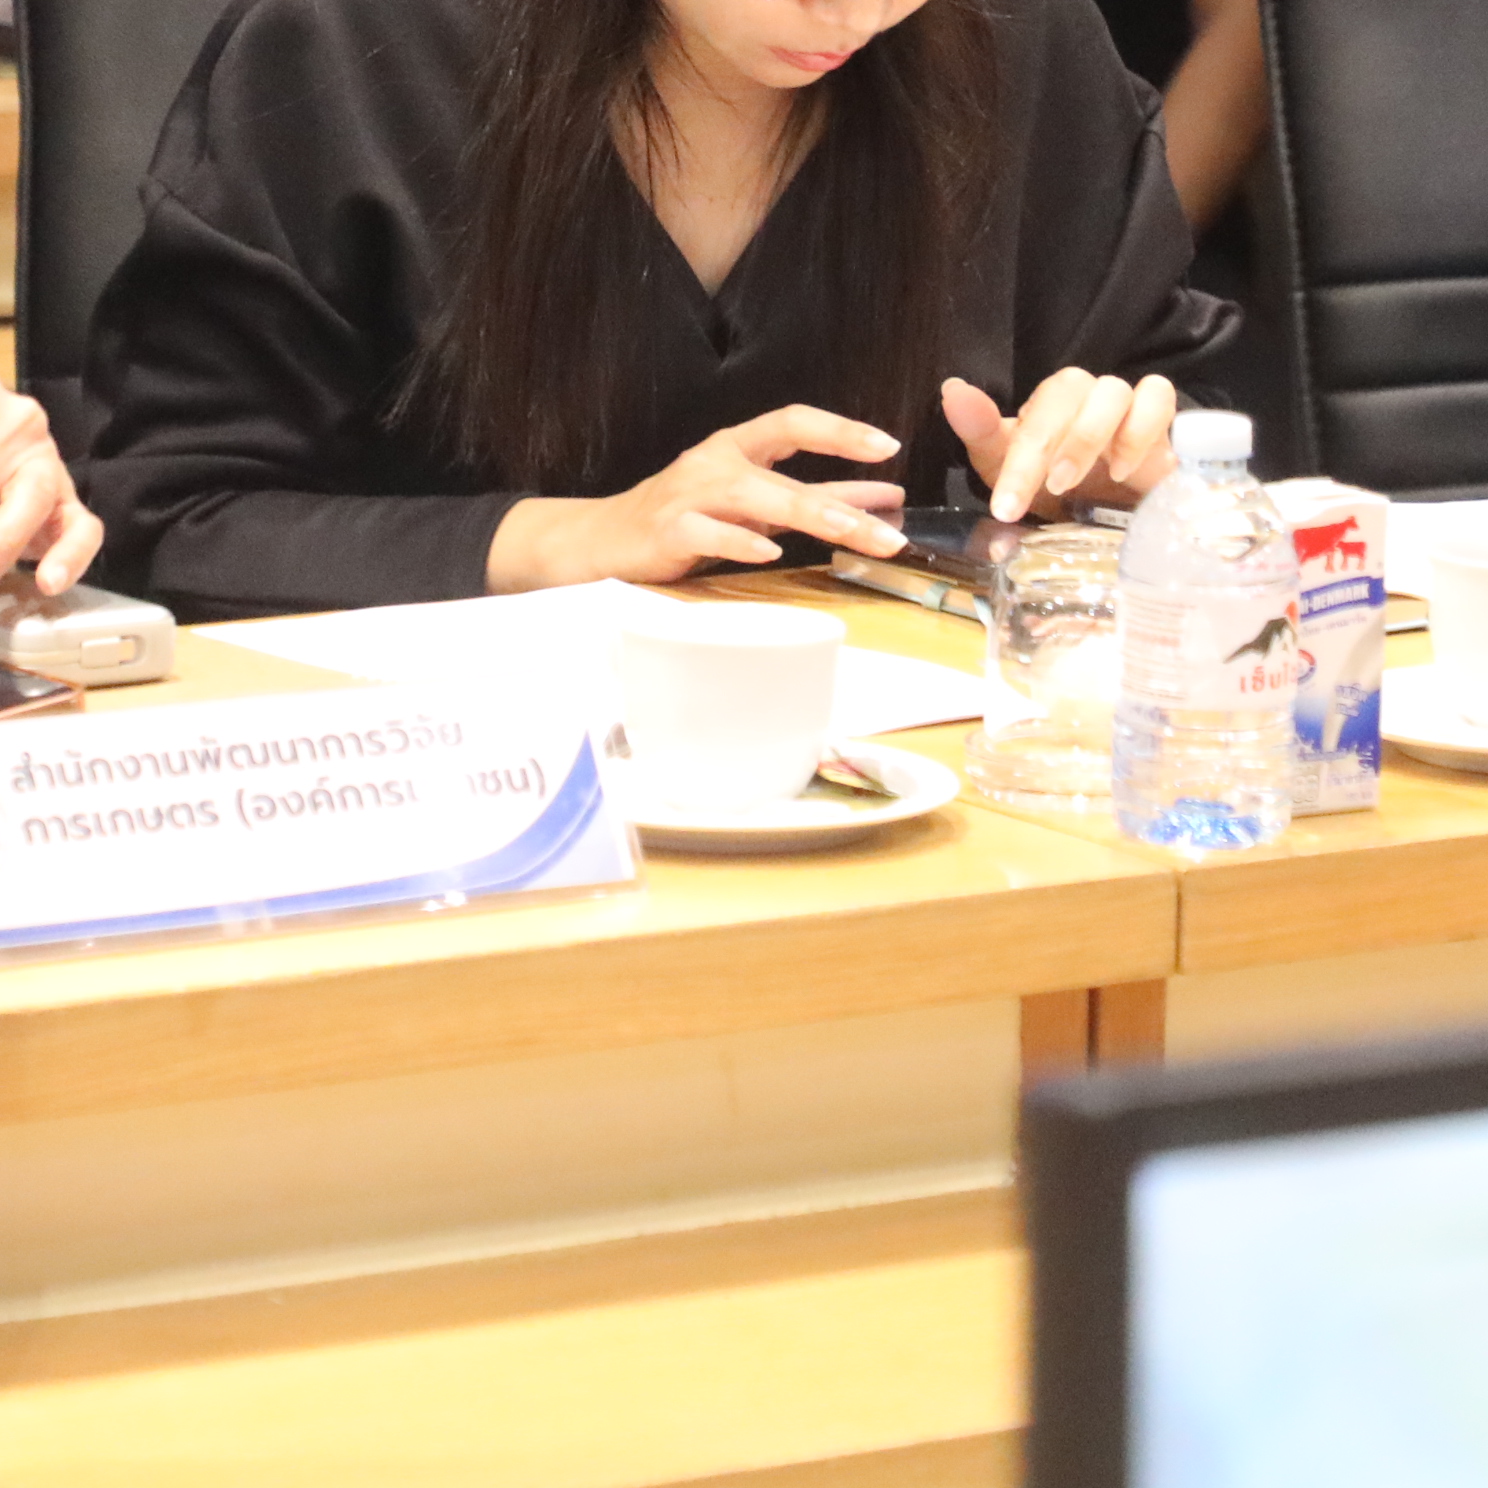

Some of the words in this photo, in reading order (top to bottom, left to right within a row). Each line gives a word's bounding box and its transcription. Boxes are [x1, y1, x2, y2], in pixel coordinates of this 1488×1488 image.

[11, 717, 464, 794] สำนักงานพัฒนาการวิจัย
[23, 792, 220, 846] การเกษตร
